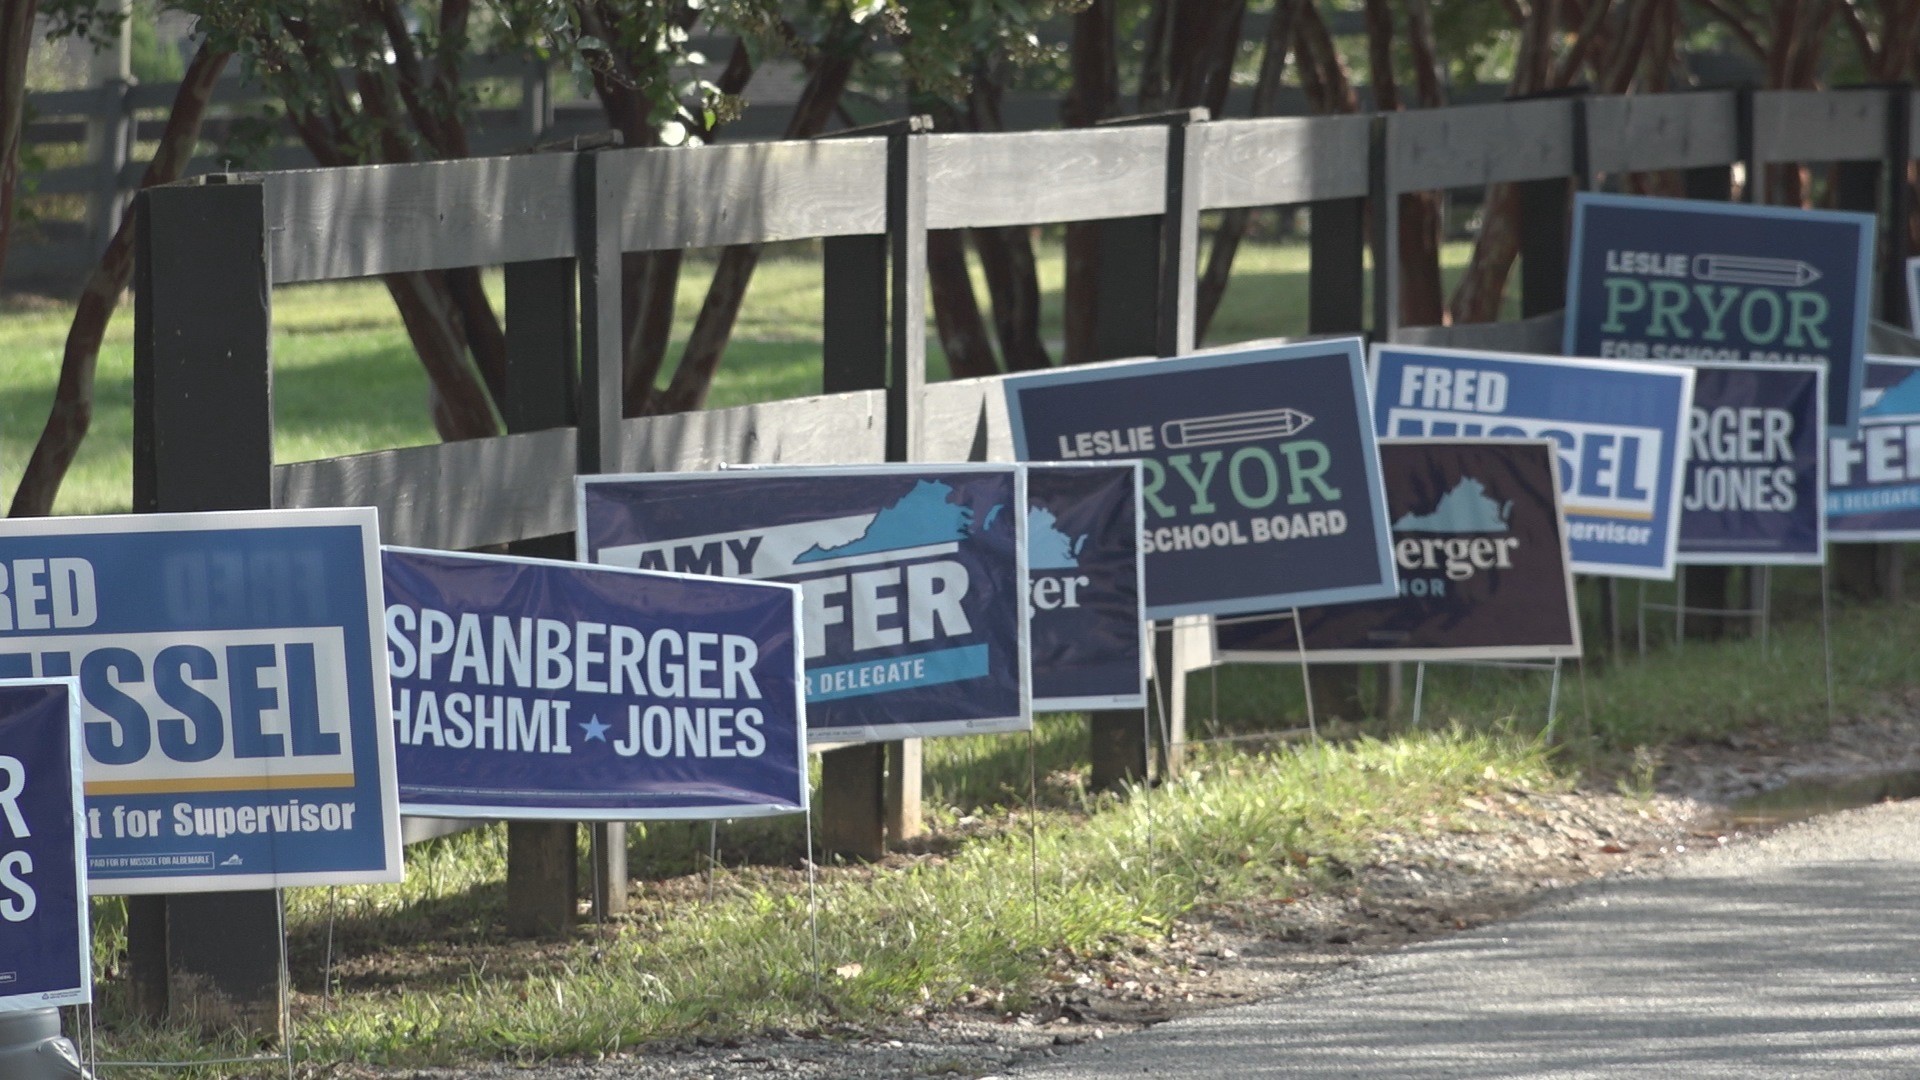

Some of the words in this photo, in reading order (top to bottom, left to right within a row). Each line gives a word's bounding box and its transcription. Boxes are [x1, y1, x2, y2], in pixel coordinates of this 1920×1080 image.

[1605, 250, 1690, 278] LESLIE
[1600, 276, 1831, 349] PRYOR
[1601, 340, 1649, 360] FOR
[1399, 364, 1510, 414] FRED
[1058, 426, 1156, 459] LESLIE
[1686, 406, 1796, 463] RGER
[1683, 465, 1798, 513] JONES
[1143, 520, 1249, 554] SCHOOL
[1251, 509, 1348, 543] BOARD
[801, 560, 973, 660] FER
[385, 604, 763, 700] SPANBERGER
[820, 658, 926, 695] DELEGATE
[613, 704, 767, 758] JONES
[112, 806, 162, 838] for
[173, 799, 356, 838] Supervisor
[90, 858, 105, 868] PAID
[106, 857, 119, 868] FOR
[119, 857, 129, 867] BY
[158, 856, 171, 866] FOR
